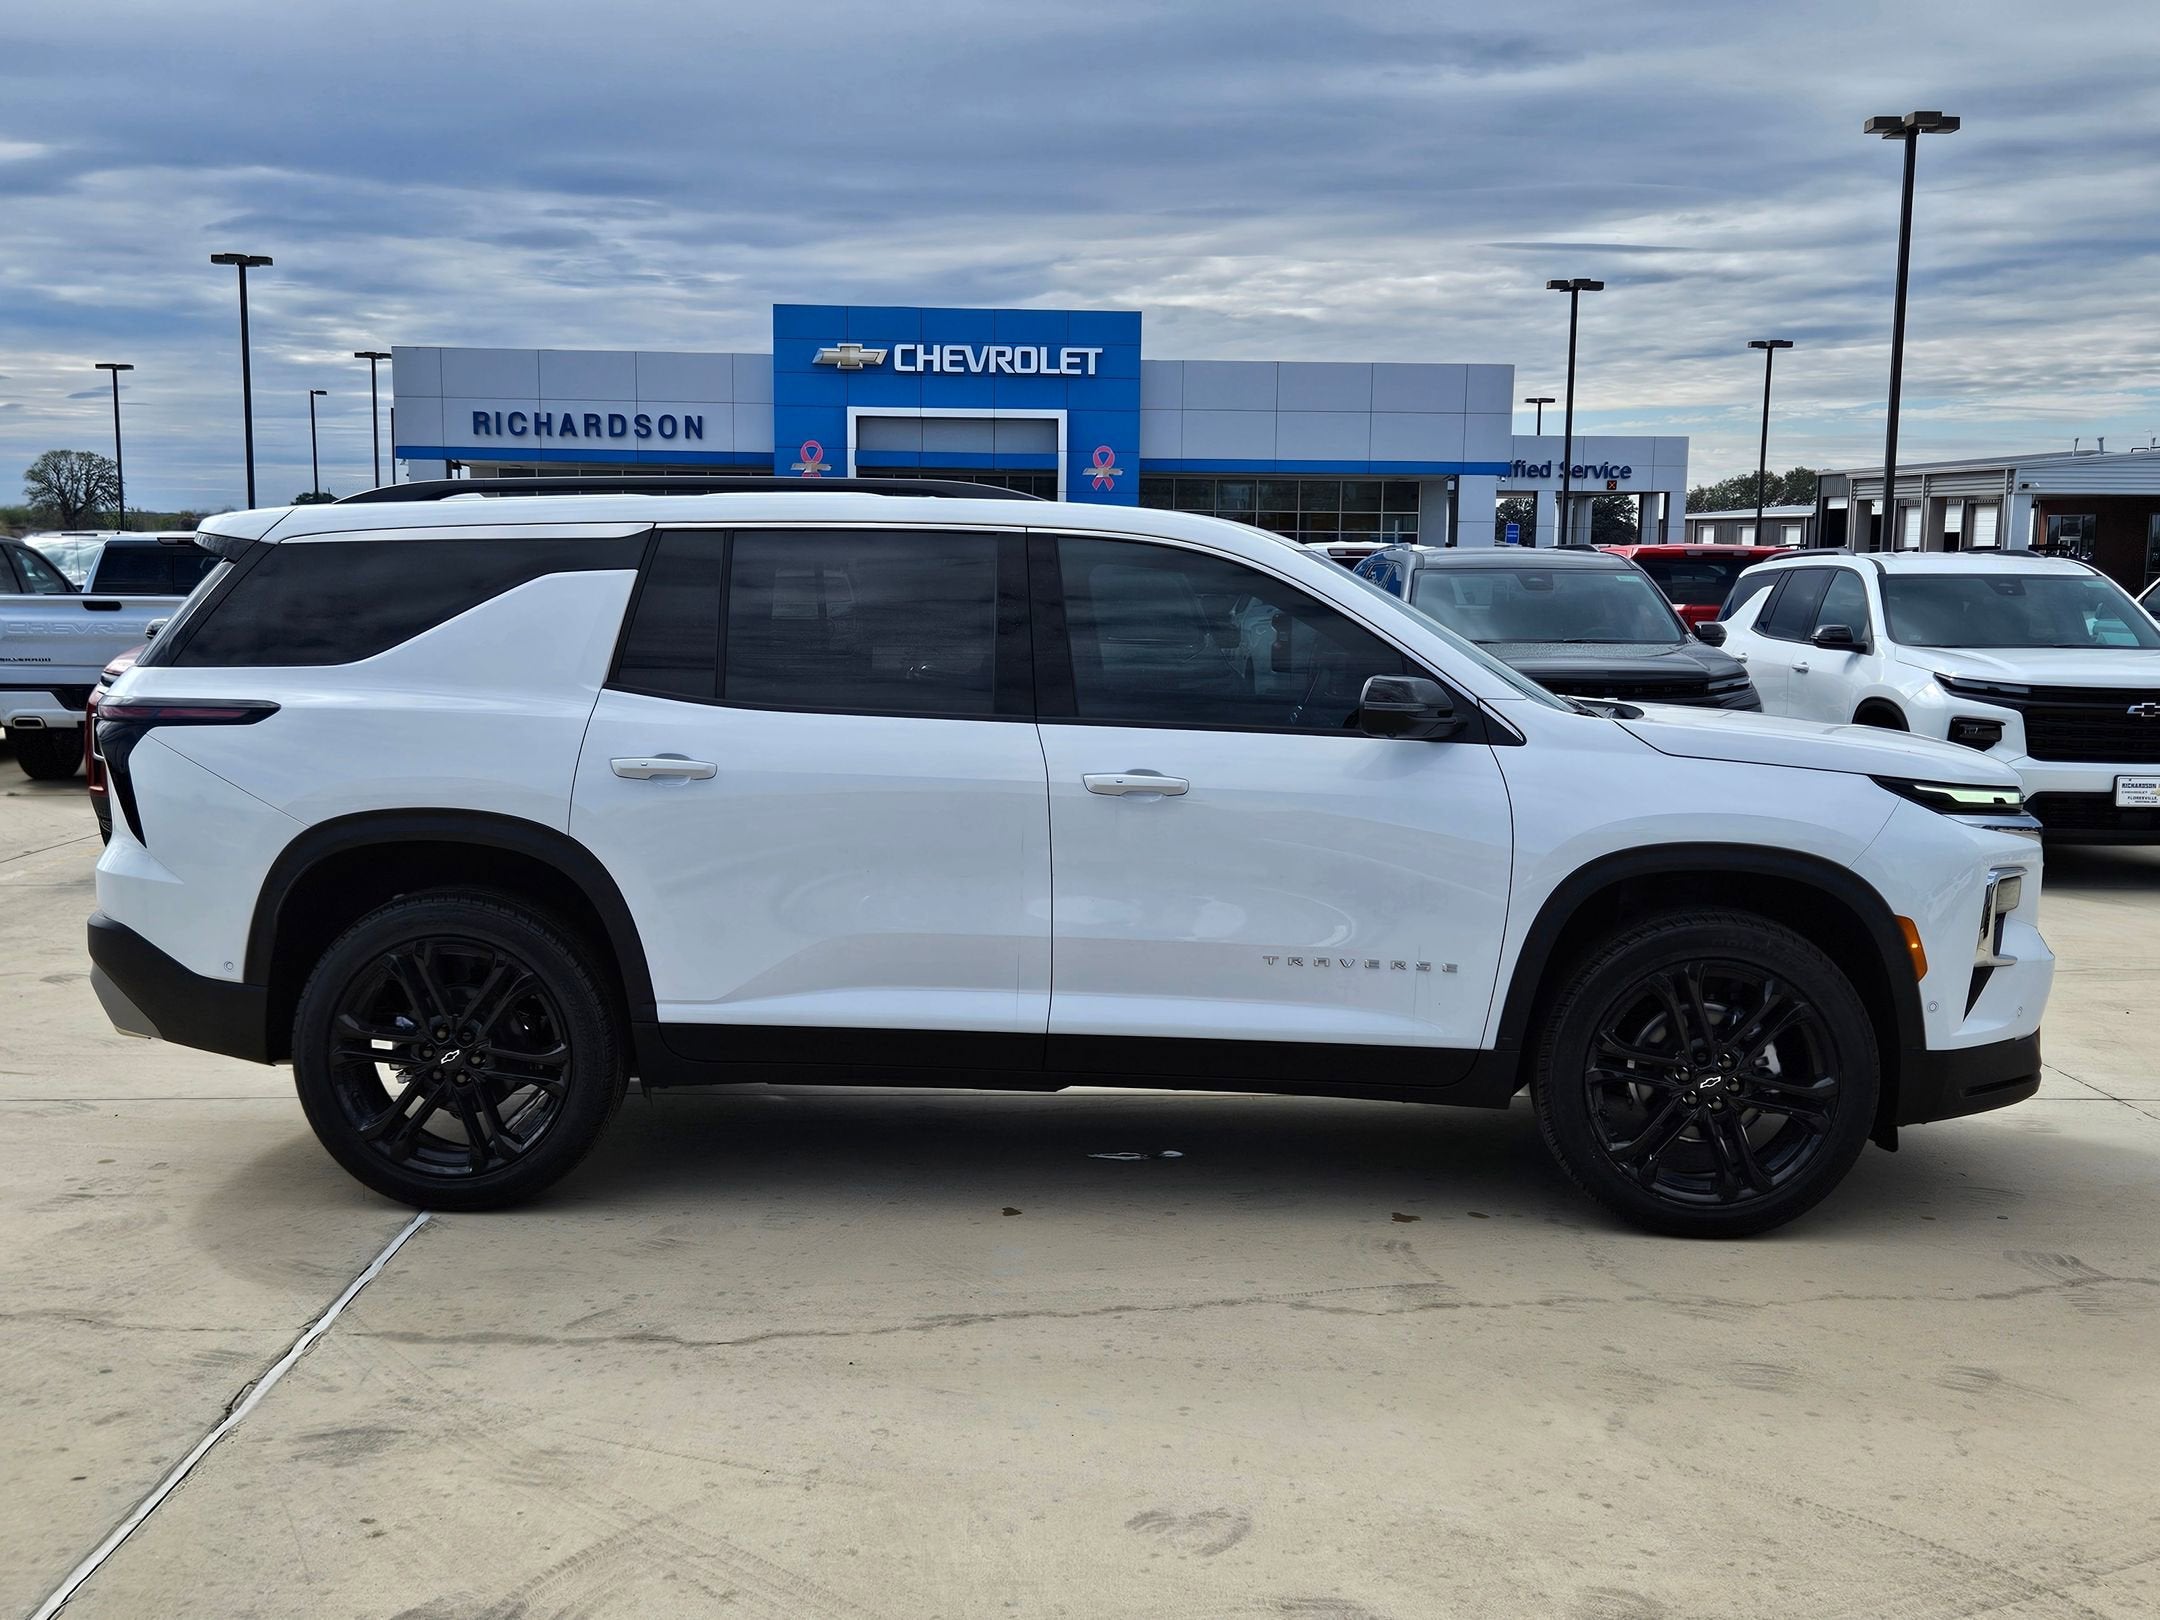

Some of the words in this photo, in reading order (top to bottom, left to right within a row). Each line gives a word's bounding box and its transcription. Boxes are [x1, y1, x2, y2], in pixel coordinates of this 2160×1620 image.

[893, 343, 1103, 376] CHEVROLET
[472, 410, 704, 440] RICHARDSON
[1262, 955, 1458, 974] TRAVERSE
